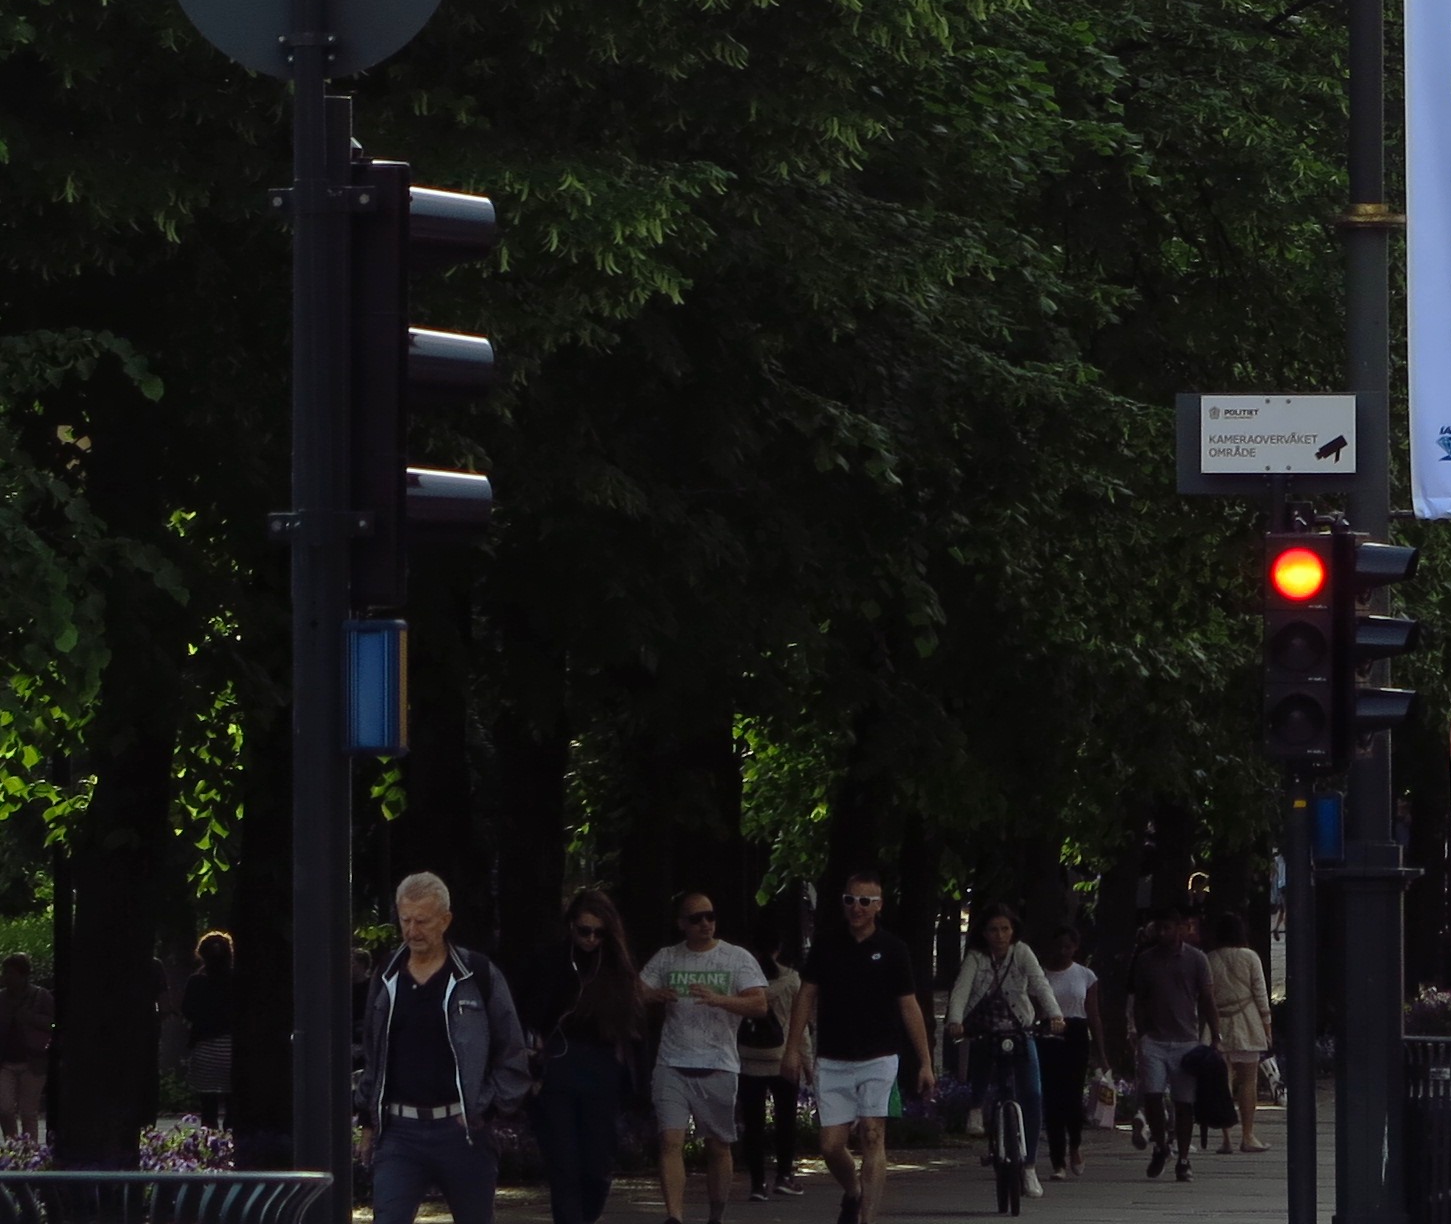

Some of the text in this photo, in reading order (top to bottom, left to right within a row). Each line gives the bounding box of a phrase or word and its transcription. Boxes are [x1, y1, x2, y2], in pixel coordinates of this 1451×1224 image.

[1208, 432, 1318, 445] KAMERAOVERVÅKET
[1208, 446, 1256, 458] OMRÅDE
[669, 972, 727, 985] INSANE
